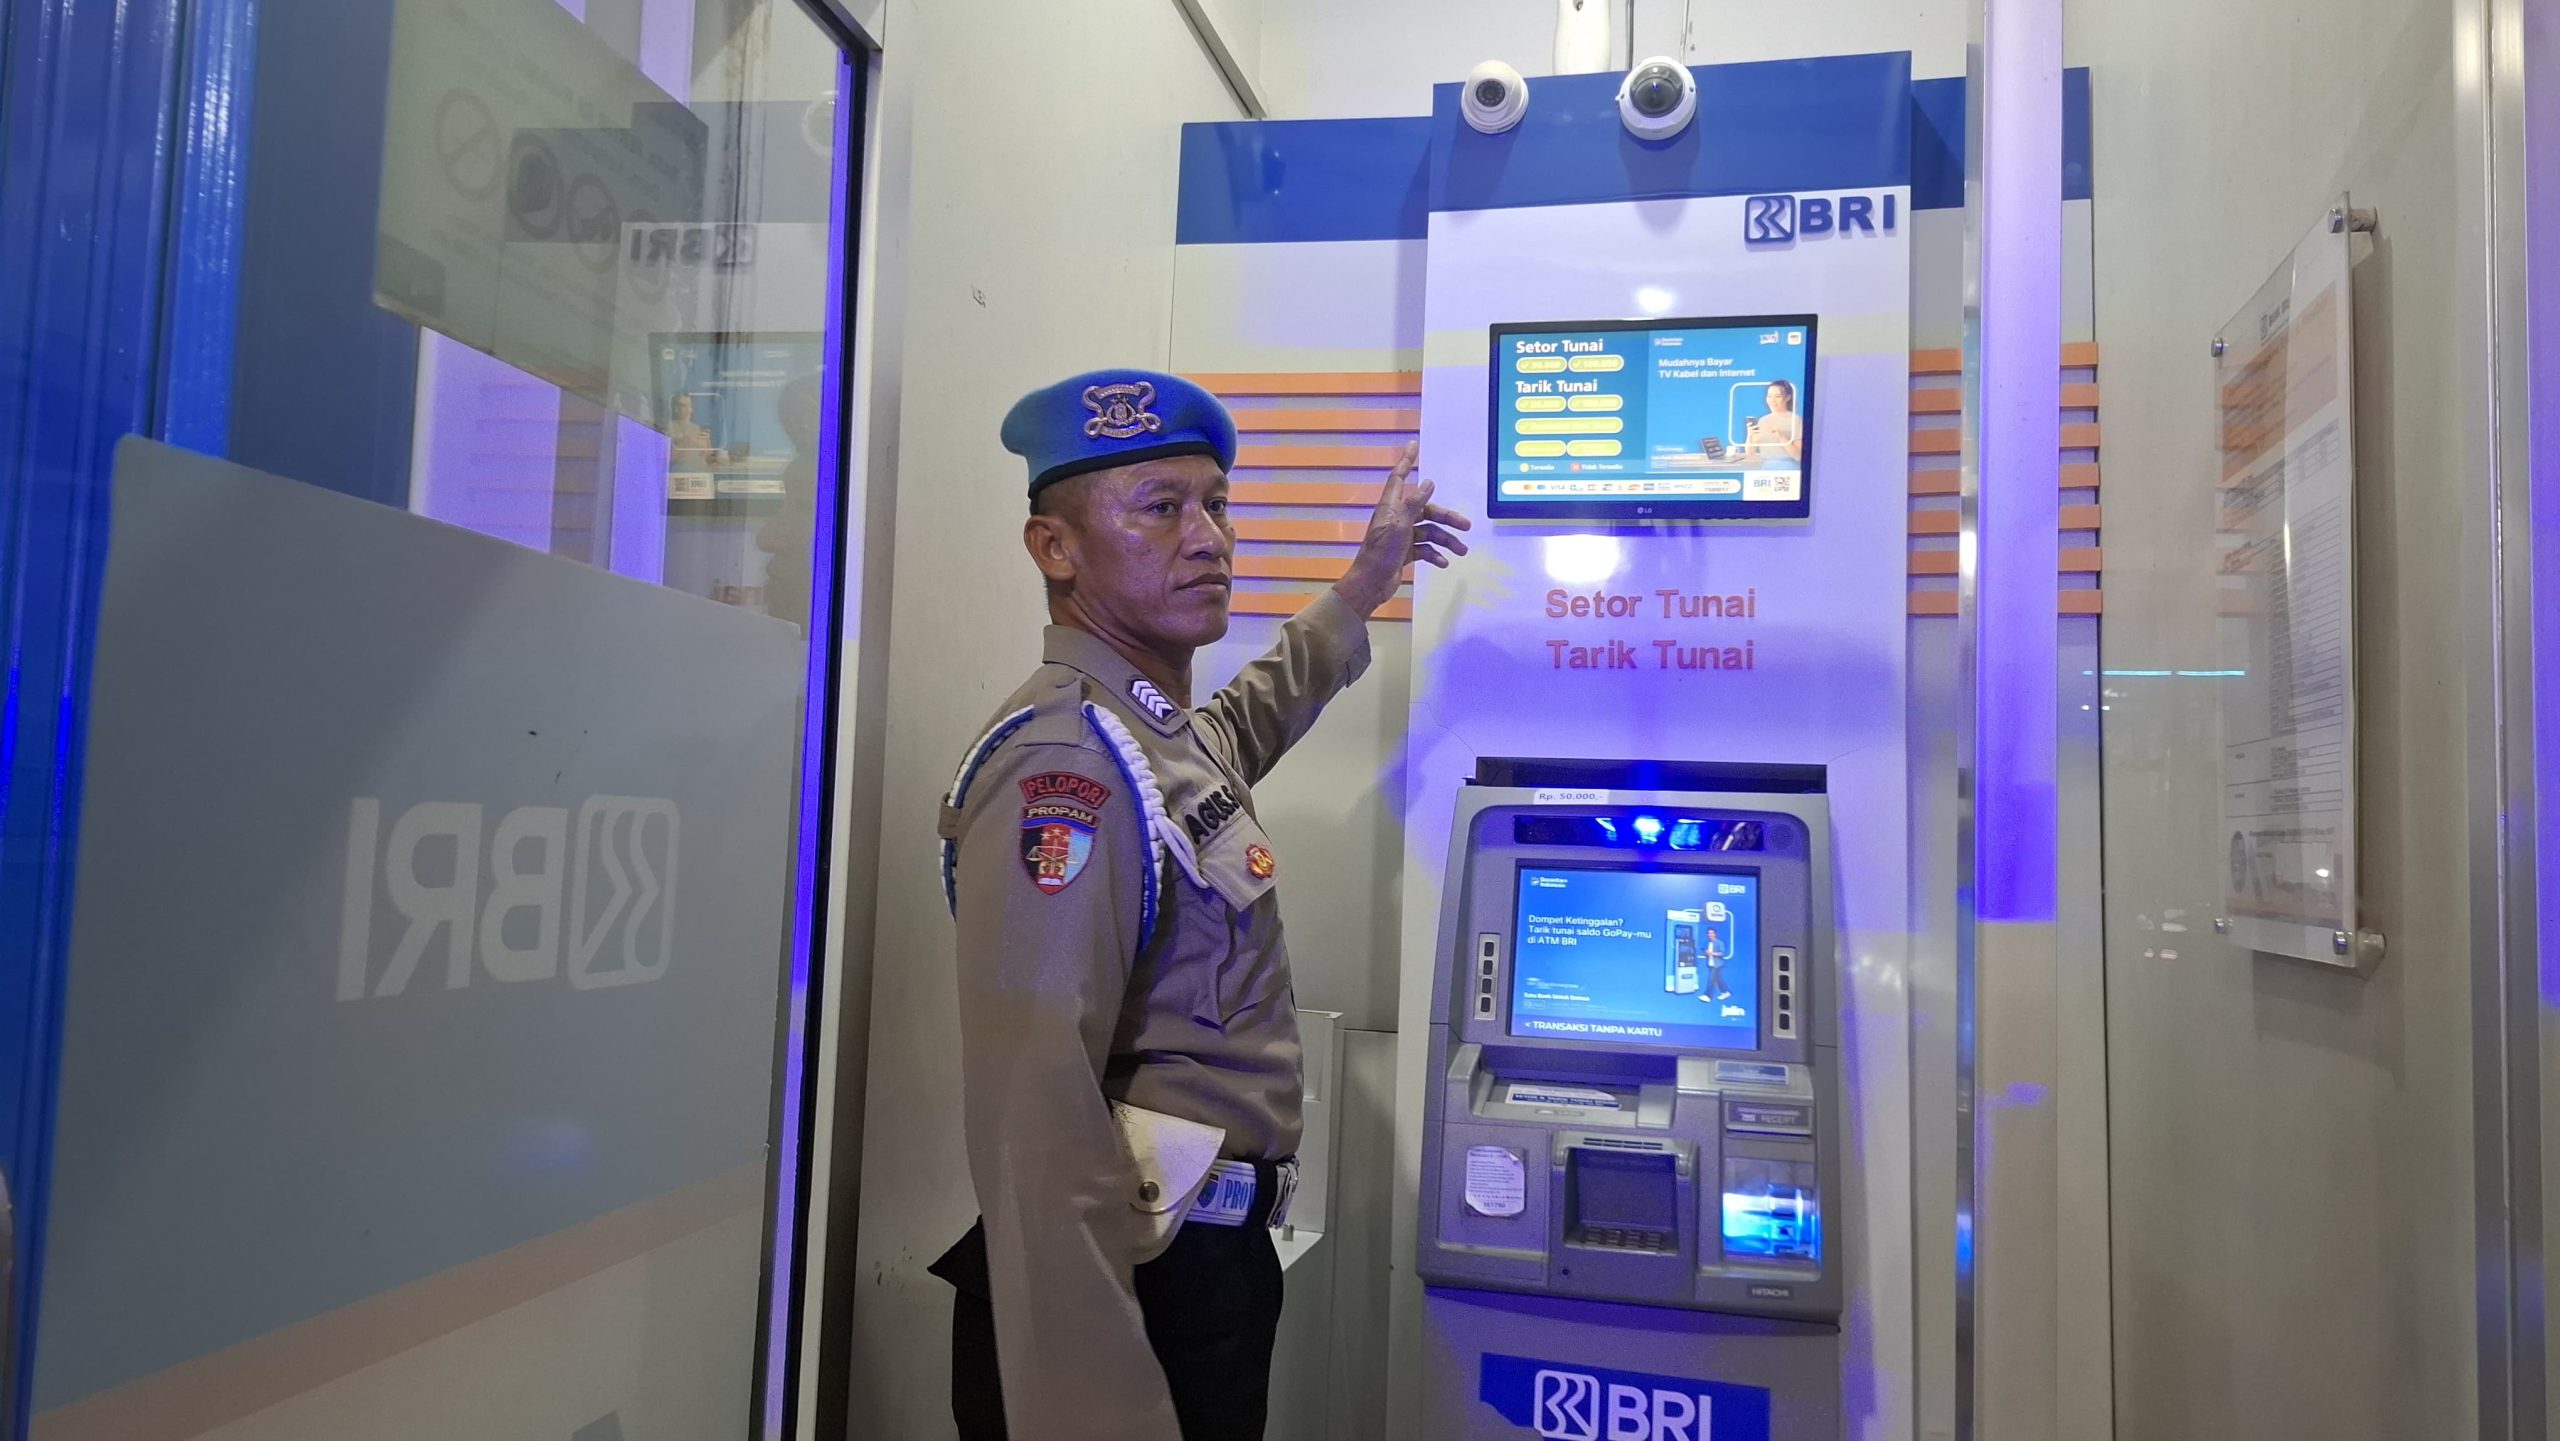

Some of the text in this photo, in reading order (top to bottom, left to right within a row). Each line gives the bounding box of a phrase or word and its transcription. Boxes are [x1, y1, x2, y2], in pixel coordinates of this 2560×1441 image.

[1800, 195, 1896, 234] BRI
[1516, 338, 1604, 354] Setor Tunai
[1658, 357, 1733, 369] Mudahnya Bayar
[1658, 368, 1756, 378] TV Kabel dan Internet
[1515, 379, 1598, 393] Tarik Tunai
[1545, 588, 1756, 618] Setor Tunai
[1546, 640, 1754, 670] Tarik Tunai
[1025, 776, 1101, 802] PELOPOR
[1539, 793, 1556, 801] Rp.
[1026, 806, 1094, 823] PROPAM
[1729, 885, 1746, 894] BRI
[1528, 915, 1624, 927] Dompet Ketinggalan?
[1529, 925, 1652, 939] Tarik tunai saldo GoPay-mu
[1527, 936, 1577, 945] di ATM BRI
[1532, 1020, 1662, 1037] TRANSAKSI TANPA KARTU
[1752, 1287, 1789, 1297] HITACHI
[1607, 1383, 1712, 1441] BRI
